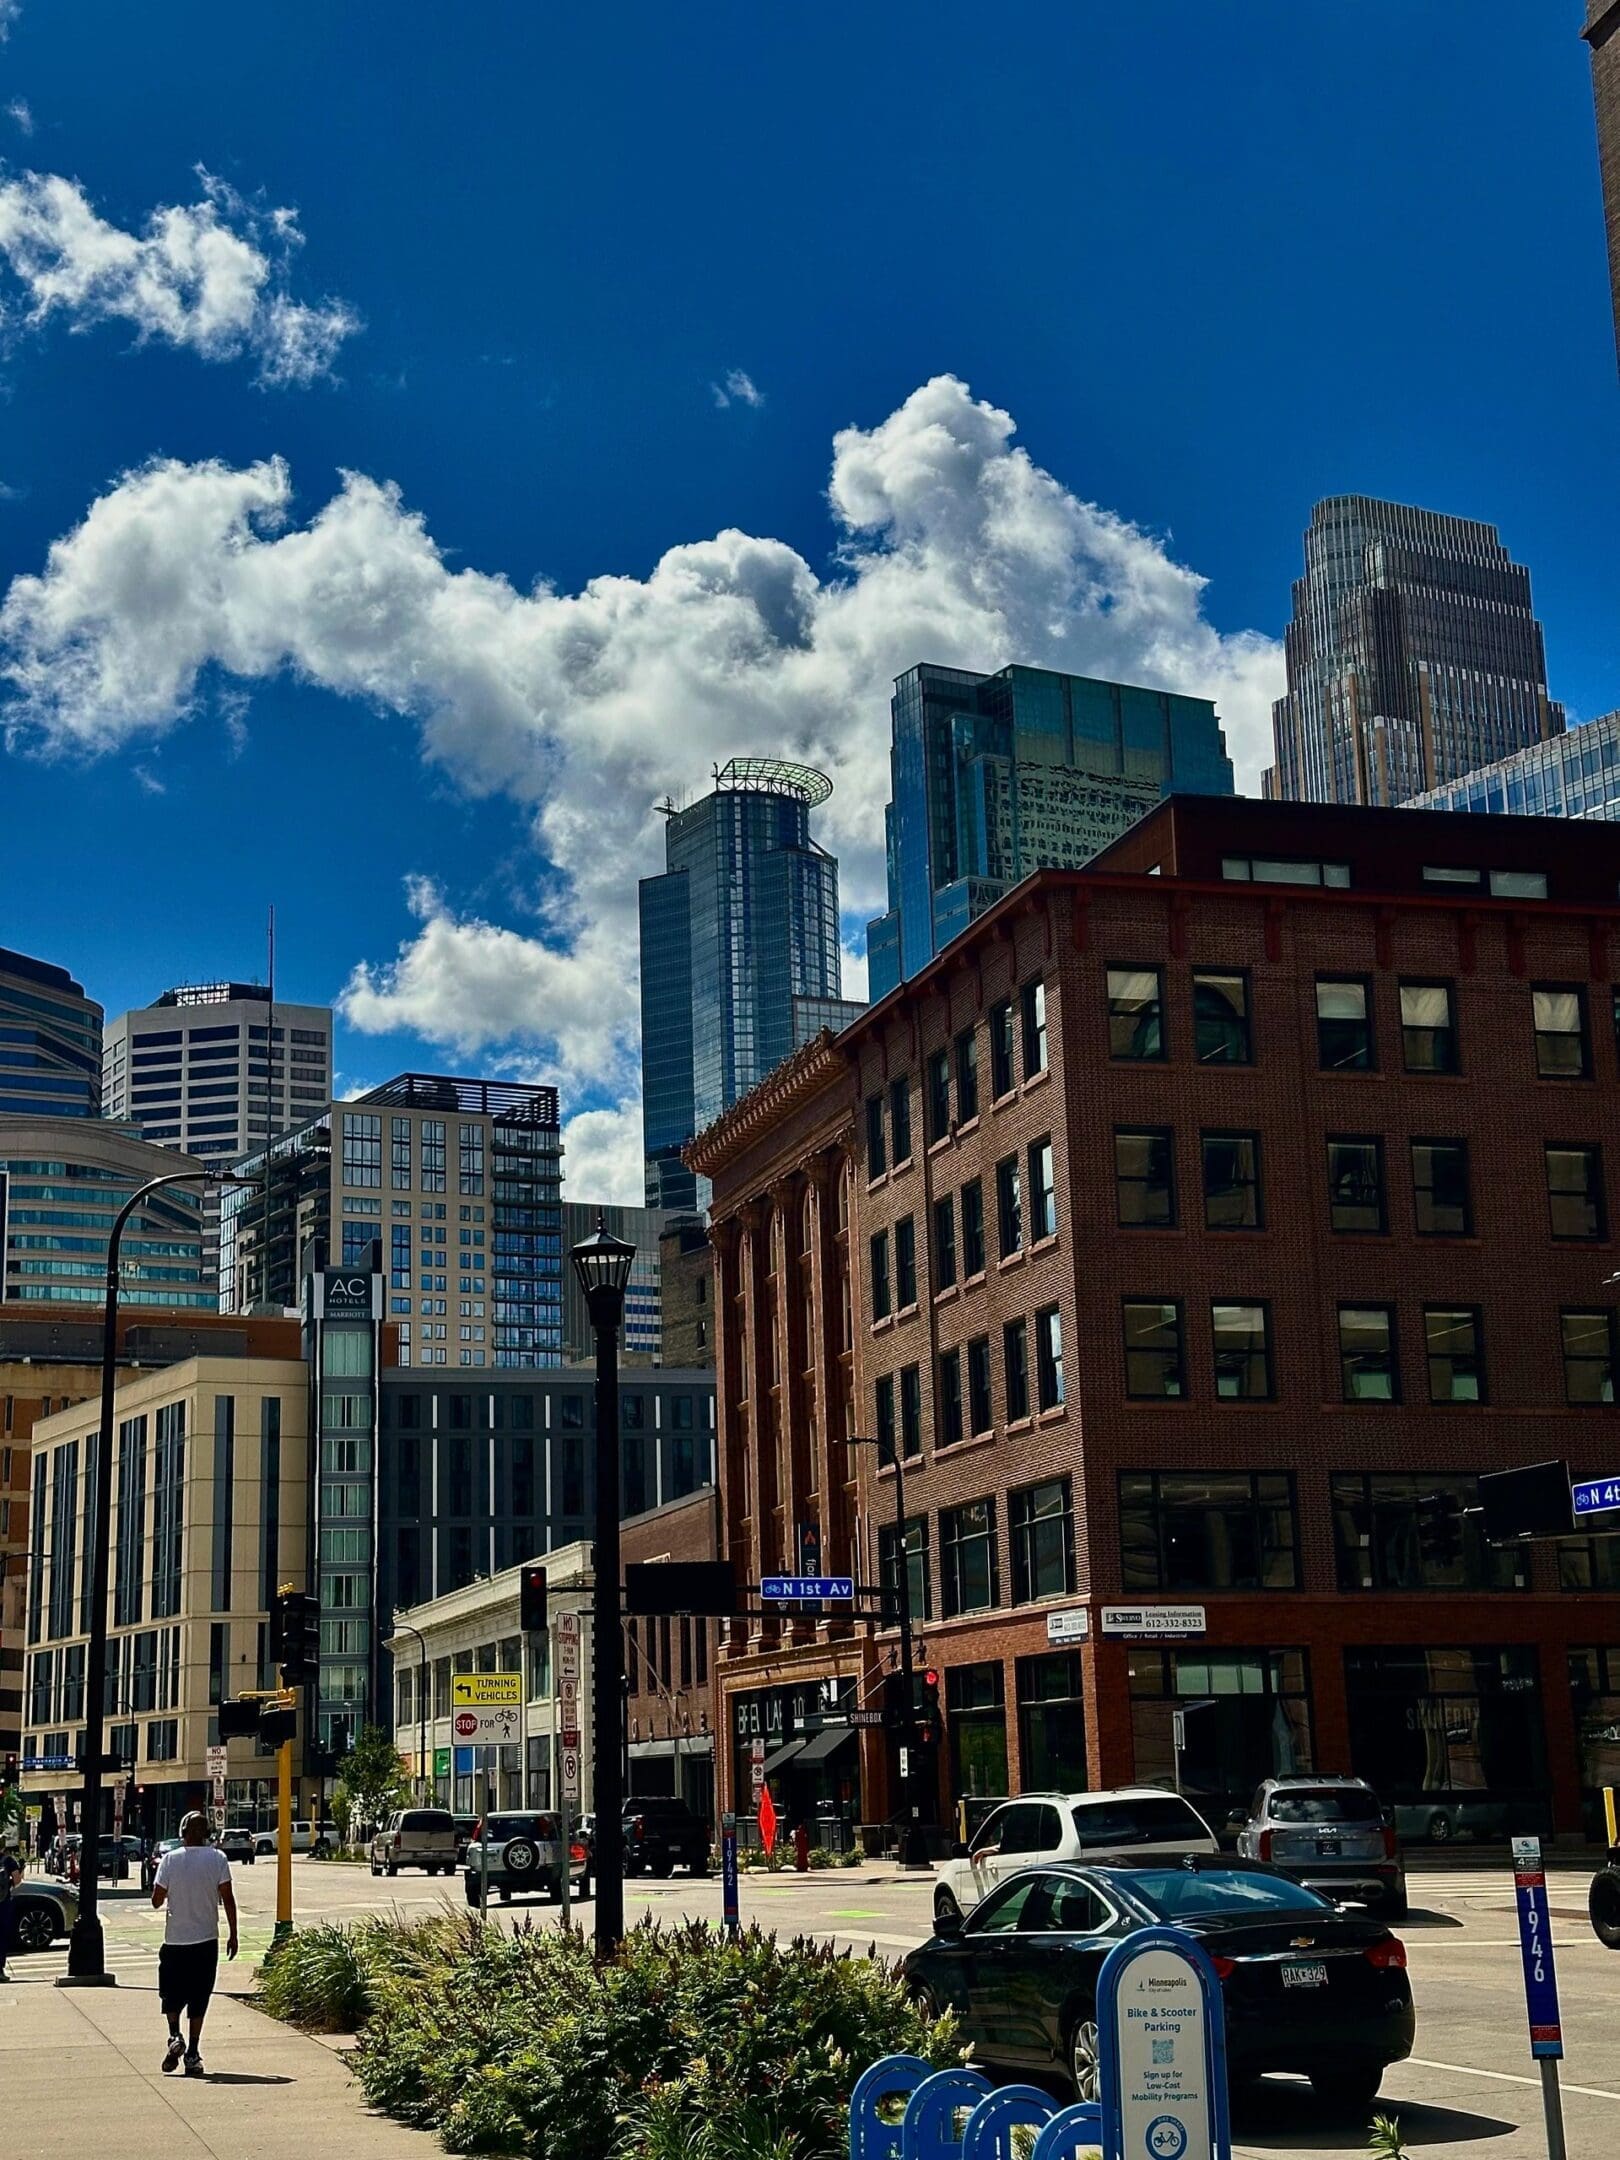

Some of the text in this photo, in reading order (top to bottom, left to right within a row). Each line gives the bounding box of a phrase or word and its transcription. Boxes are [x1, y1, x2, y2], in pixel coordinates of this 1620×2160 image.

[330, 1278, 365, 1296] AC
[1590, 1484, 1620, 1505] N 4t
[805, 1558, 816, 1577] fjor
[783, 1582, 849, 1595] N 1st Av
[1145, 1610, 1202, 1619] Leasing Information
[563, 1615, 573, 1632] NO
[1146, 1619, 1202, 1628] 612-332-8323
[476, 1678, 517, 1689] TURNING
[475, 1690, 518, 1701] VEHICLES
[850, 1711, 883, 1724] SHINEBOX
[455, 1719, 495, 1730] STOP FOR
[726, 1837, 734, 1886] 1942
[1517, 1857, 1525, 1866] 4
[1526, 1887, 1544, 1982] 1946
[1148, 1977, 1187, 1989] Minneapolis
[1127, 2007, 1197, 2018] Bike & Scooter
[1144, 2022, 1181, 2034] Parking
[1143, 2070, 1183, 2080] Sign up for
[1147, 2082, 1181, 2090] Low-Cost
[1132, 2092, 1198, 2101] Mobility Programs
